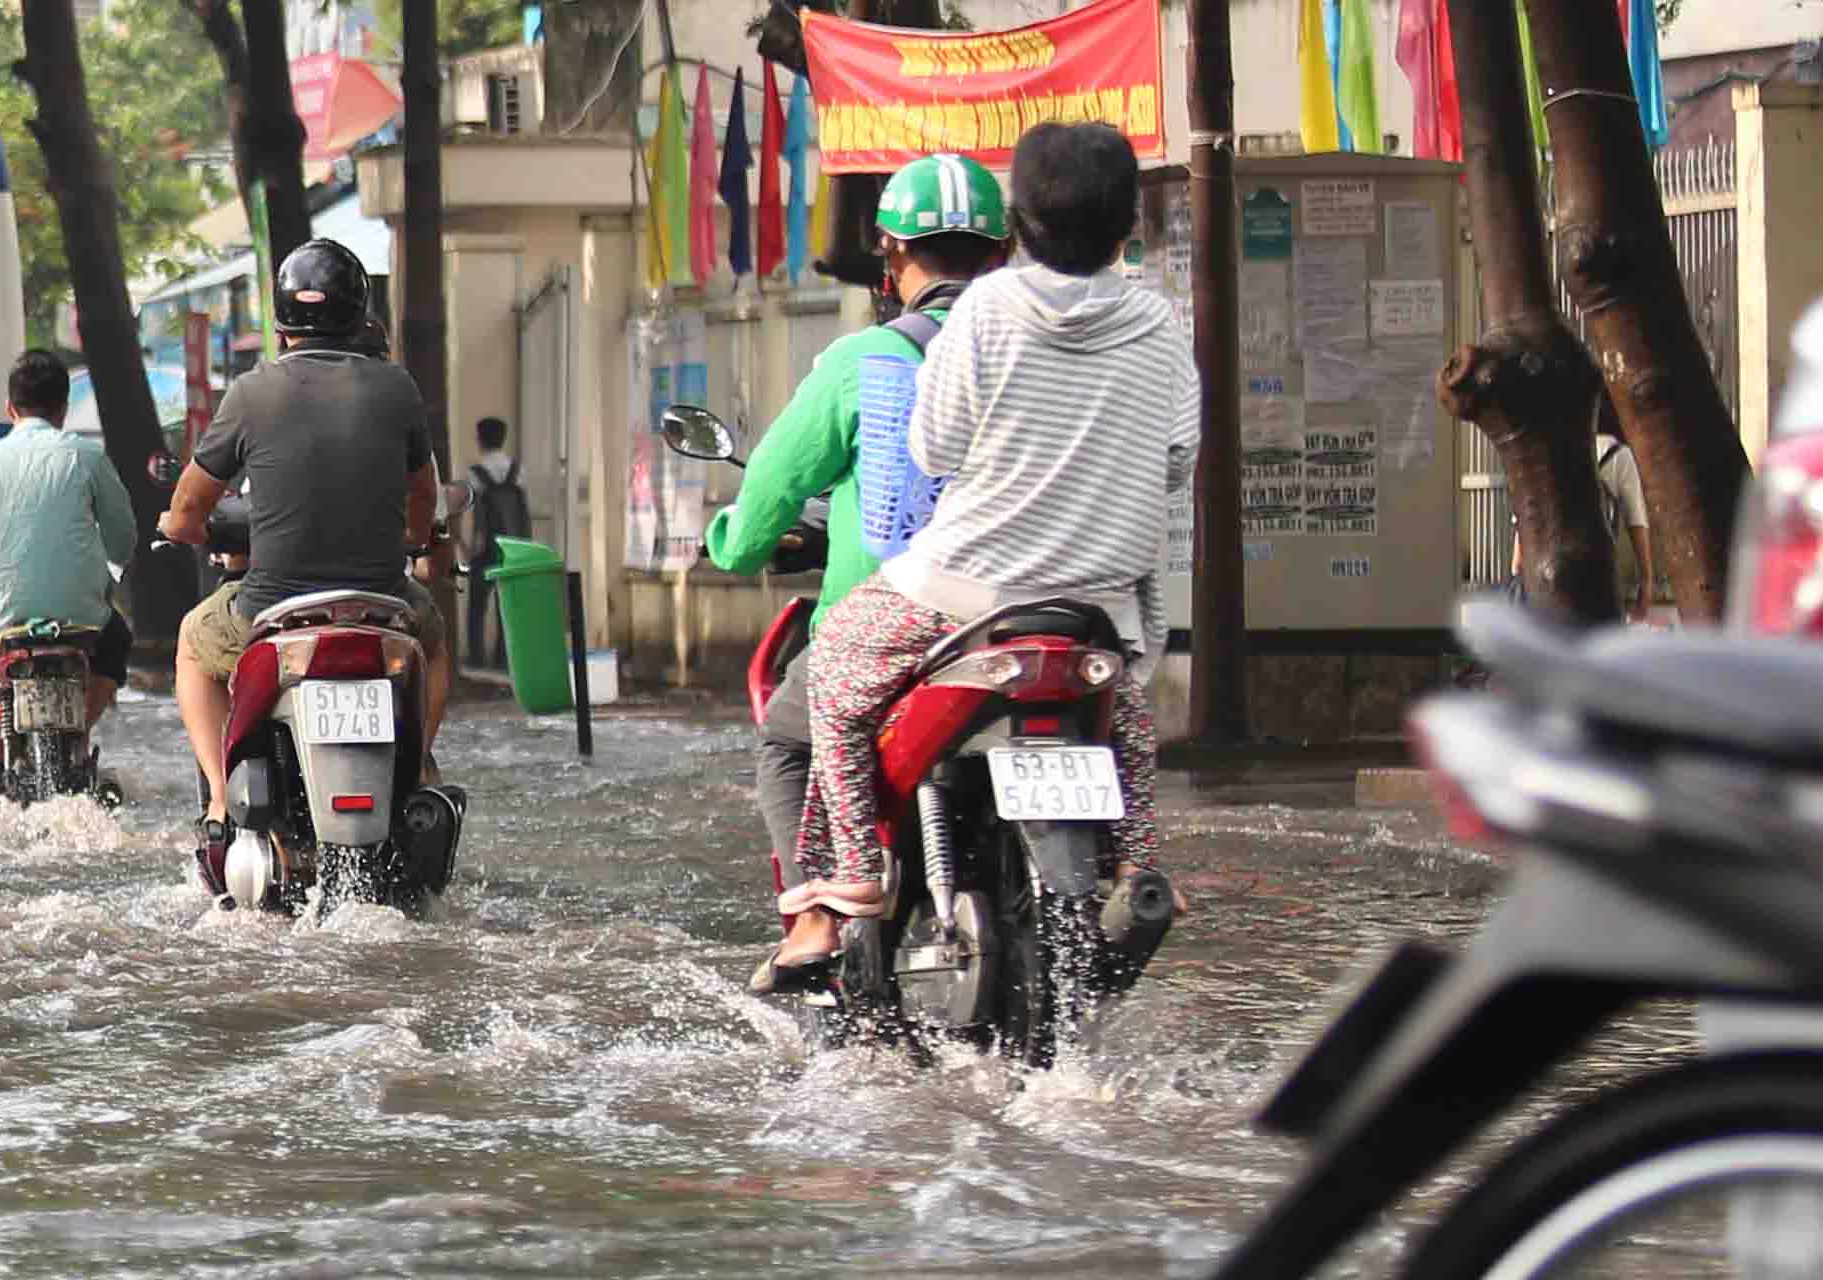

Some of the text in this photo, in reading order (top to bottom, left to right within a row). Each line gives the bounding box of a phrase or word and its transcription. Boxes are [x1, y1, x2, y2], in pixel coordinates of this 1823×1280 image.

[316, 685, 380, 711] 51-X9
[318, 712, 380, 737] 0748
[1011, 753, 1094, 781] 63-B1
